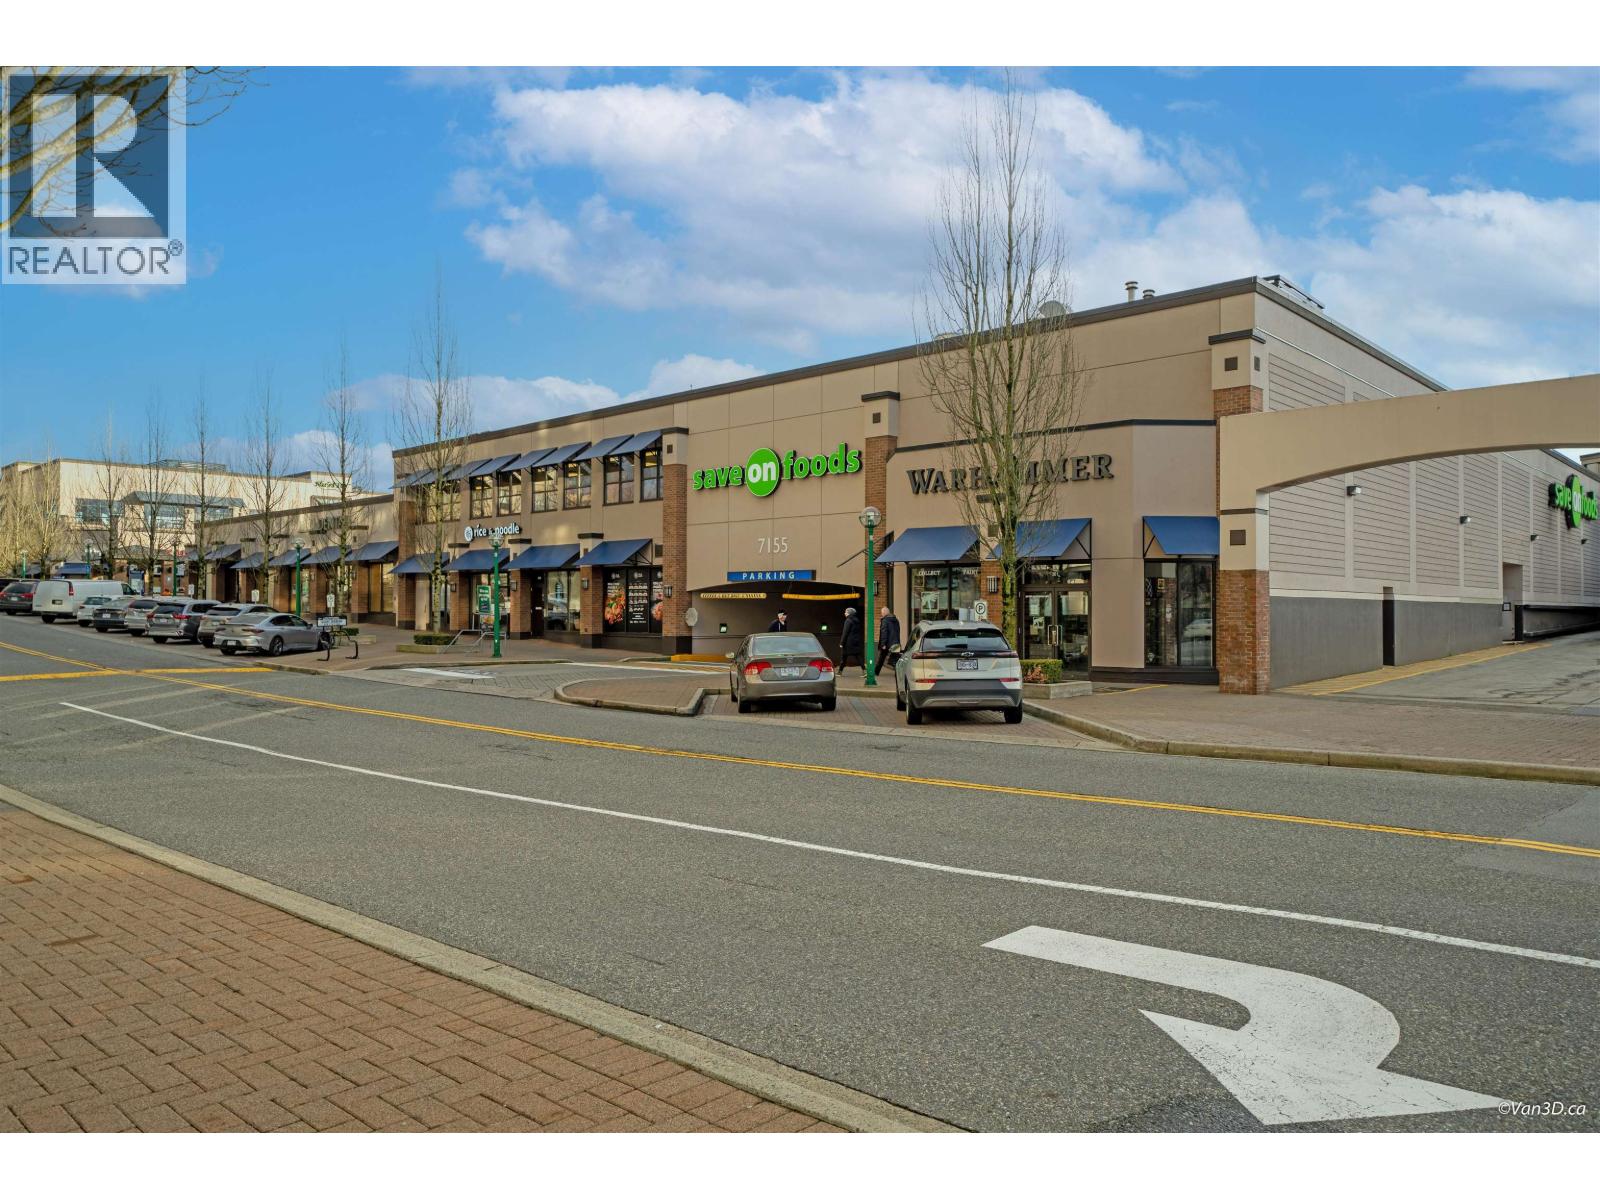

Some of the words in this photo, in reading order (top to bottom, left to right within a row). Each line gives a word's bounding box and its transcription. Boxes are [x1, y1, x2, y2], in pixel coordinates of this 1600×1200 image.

[692, 465, 742, 491] save
[747, 461, 777, 483] on
[782, 442, 861, 480] foods
[1555, 481, 1572, 511] save
[1572, 491, 1582, 513] on
[473, 523, 487, 537] rice
[495, 522, 520, 535] noodle
[758, 537, 788, 553] 7155
[742, 571, 795, 580] PARKING
